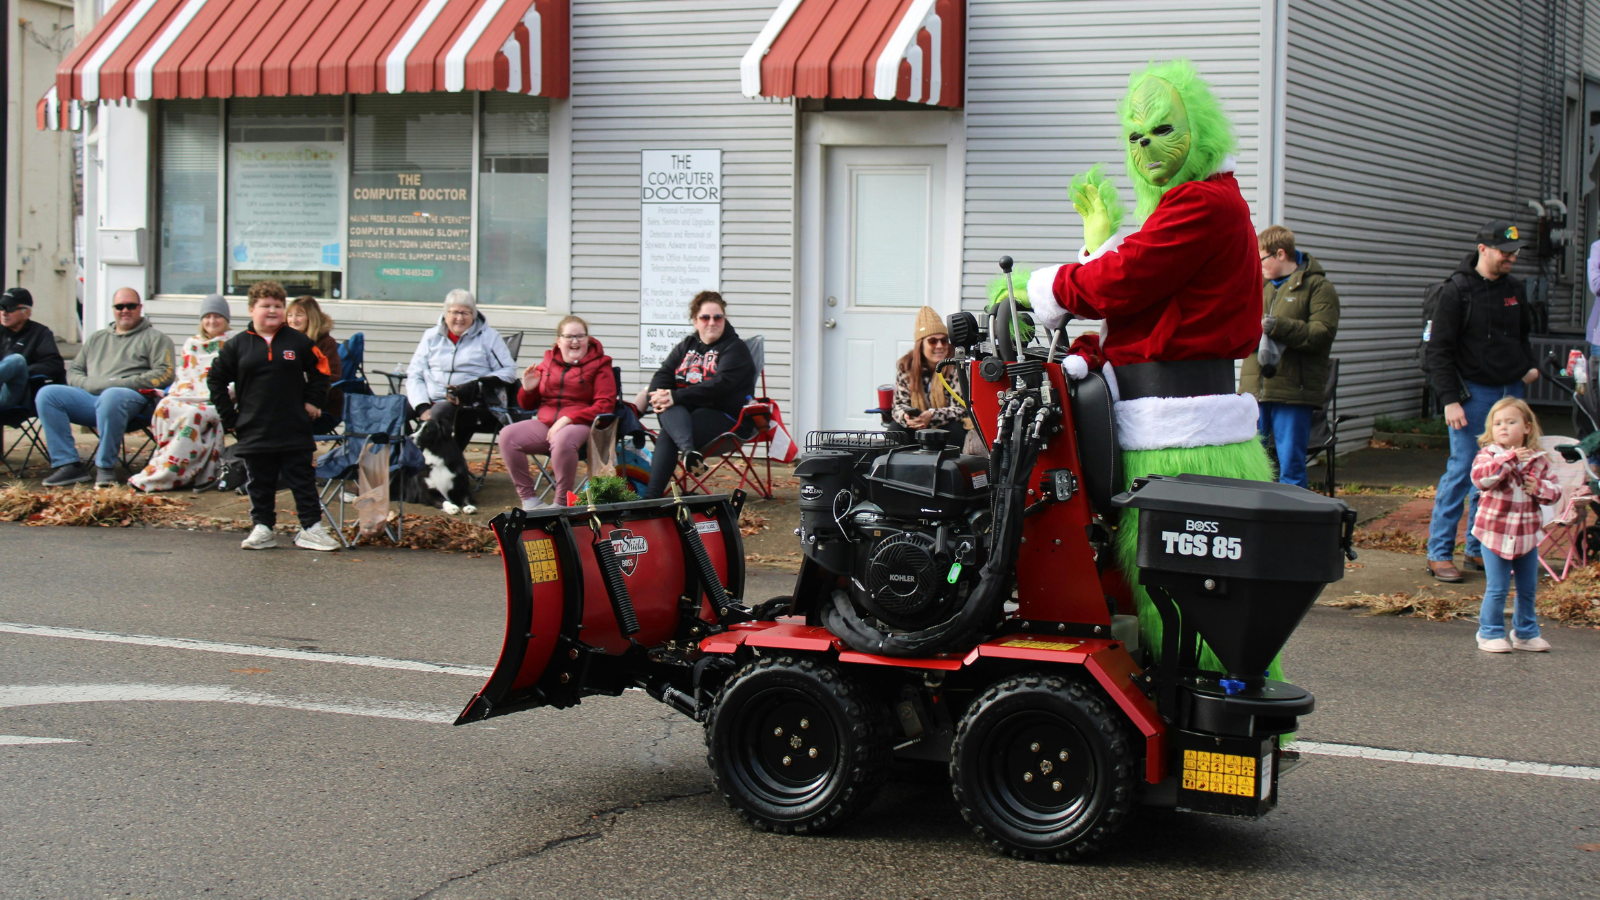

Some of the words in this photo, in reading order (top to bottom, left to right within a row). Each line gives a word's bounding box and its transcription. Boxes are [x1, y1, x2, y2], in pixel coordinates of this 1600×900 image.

[235, 149, 252, 161] The
[254, 149, 303, 163] Computer
[305, 149, 338, 161] Doctor
[671, 154, 691, 169] THE
[398, 174, 421, 186] THE
[648, 172, 714, 185] COMPUTER
[353, 188, 416, 200] COMPUTER
[419, 188, 467, 200] DOCTOR
[644, 186, 718, 200] DOCTOR
[680, 206, 703, 215] Computer
[350, 215, 369, 223] HAVING
[370, 215, 397, 223] PROBLEMS
[428, 216, 438, 224] THE
[692, 218, 715, 227] Upgrades
[350, 227, 394, 236] COMPUTER
[396, 228, 434, 236] RUNNING
[436, 229, 469, 237] SLOW??
[349, 240, 363, 248] DOES
[365, 240, 379, 248] YOUR
[380, 240, 387, 248] PC
[389, 240, 418, 248] SHUTDOWN
[679, 276, 699, 285] Systems
[643, 288, 649, 296] PC
[651, 288, 673, 296] Hardware
[680, 289, 697, 297] Softwa
[642, 299, 655, 307] 24/7
[665, 299, 674, 307] Call
[676, 300, 688, 309] Supp
[647, 329, 657, 337] 603
[658, 329, 665, 338] N.
[667, 329, 688, 338] Columb
[650, 343, 668, 351] Phone:
[1186, 520, 1219, 533] BOSS
[613, 535, 645, 552] artShield
[1162, 531, 1208, 557] TGS
[1212, 536, 1242, 560] 85
[621, 559, 634, 567] BOSS
[890, 574, 915, 582] KOHLER
